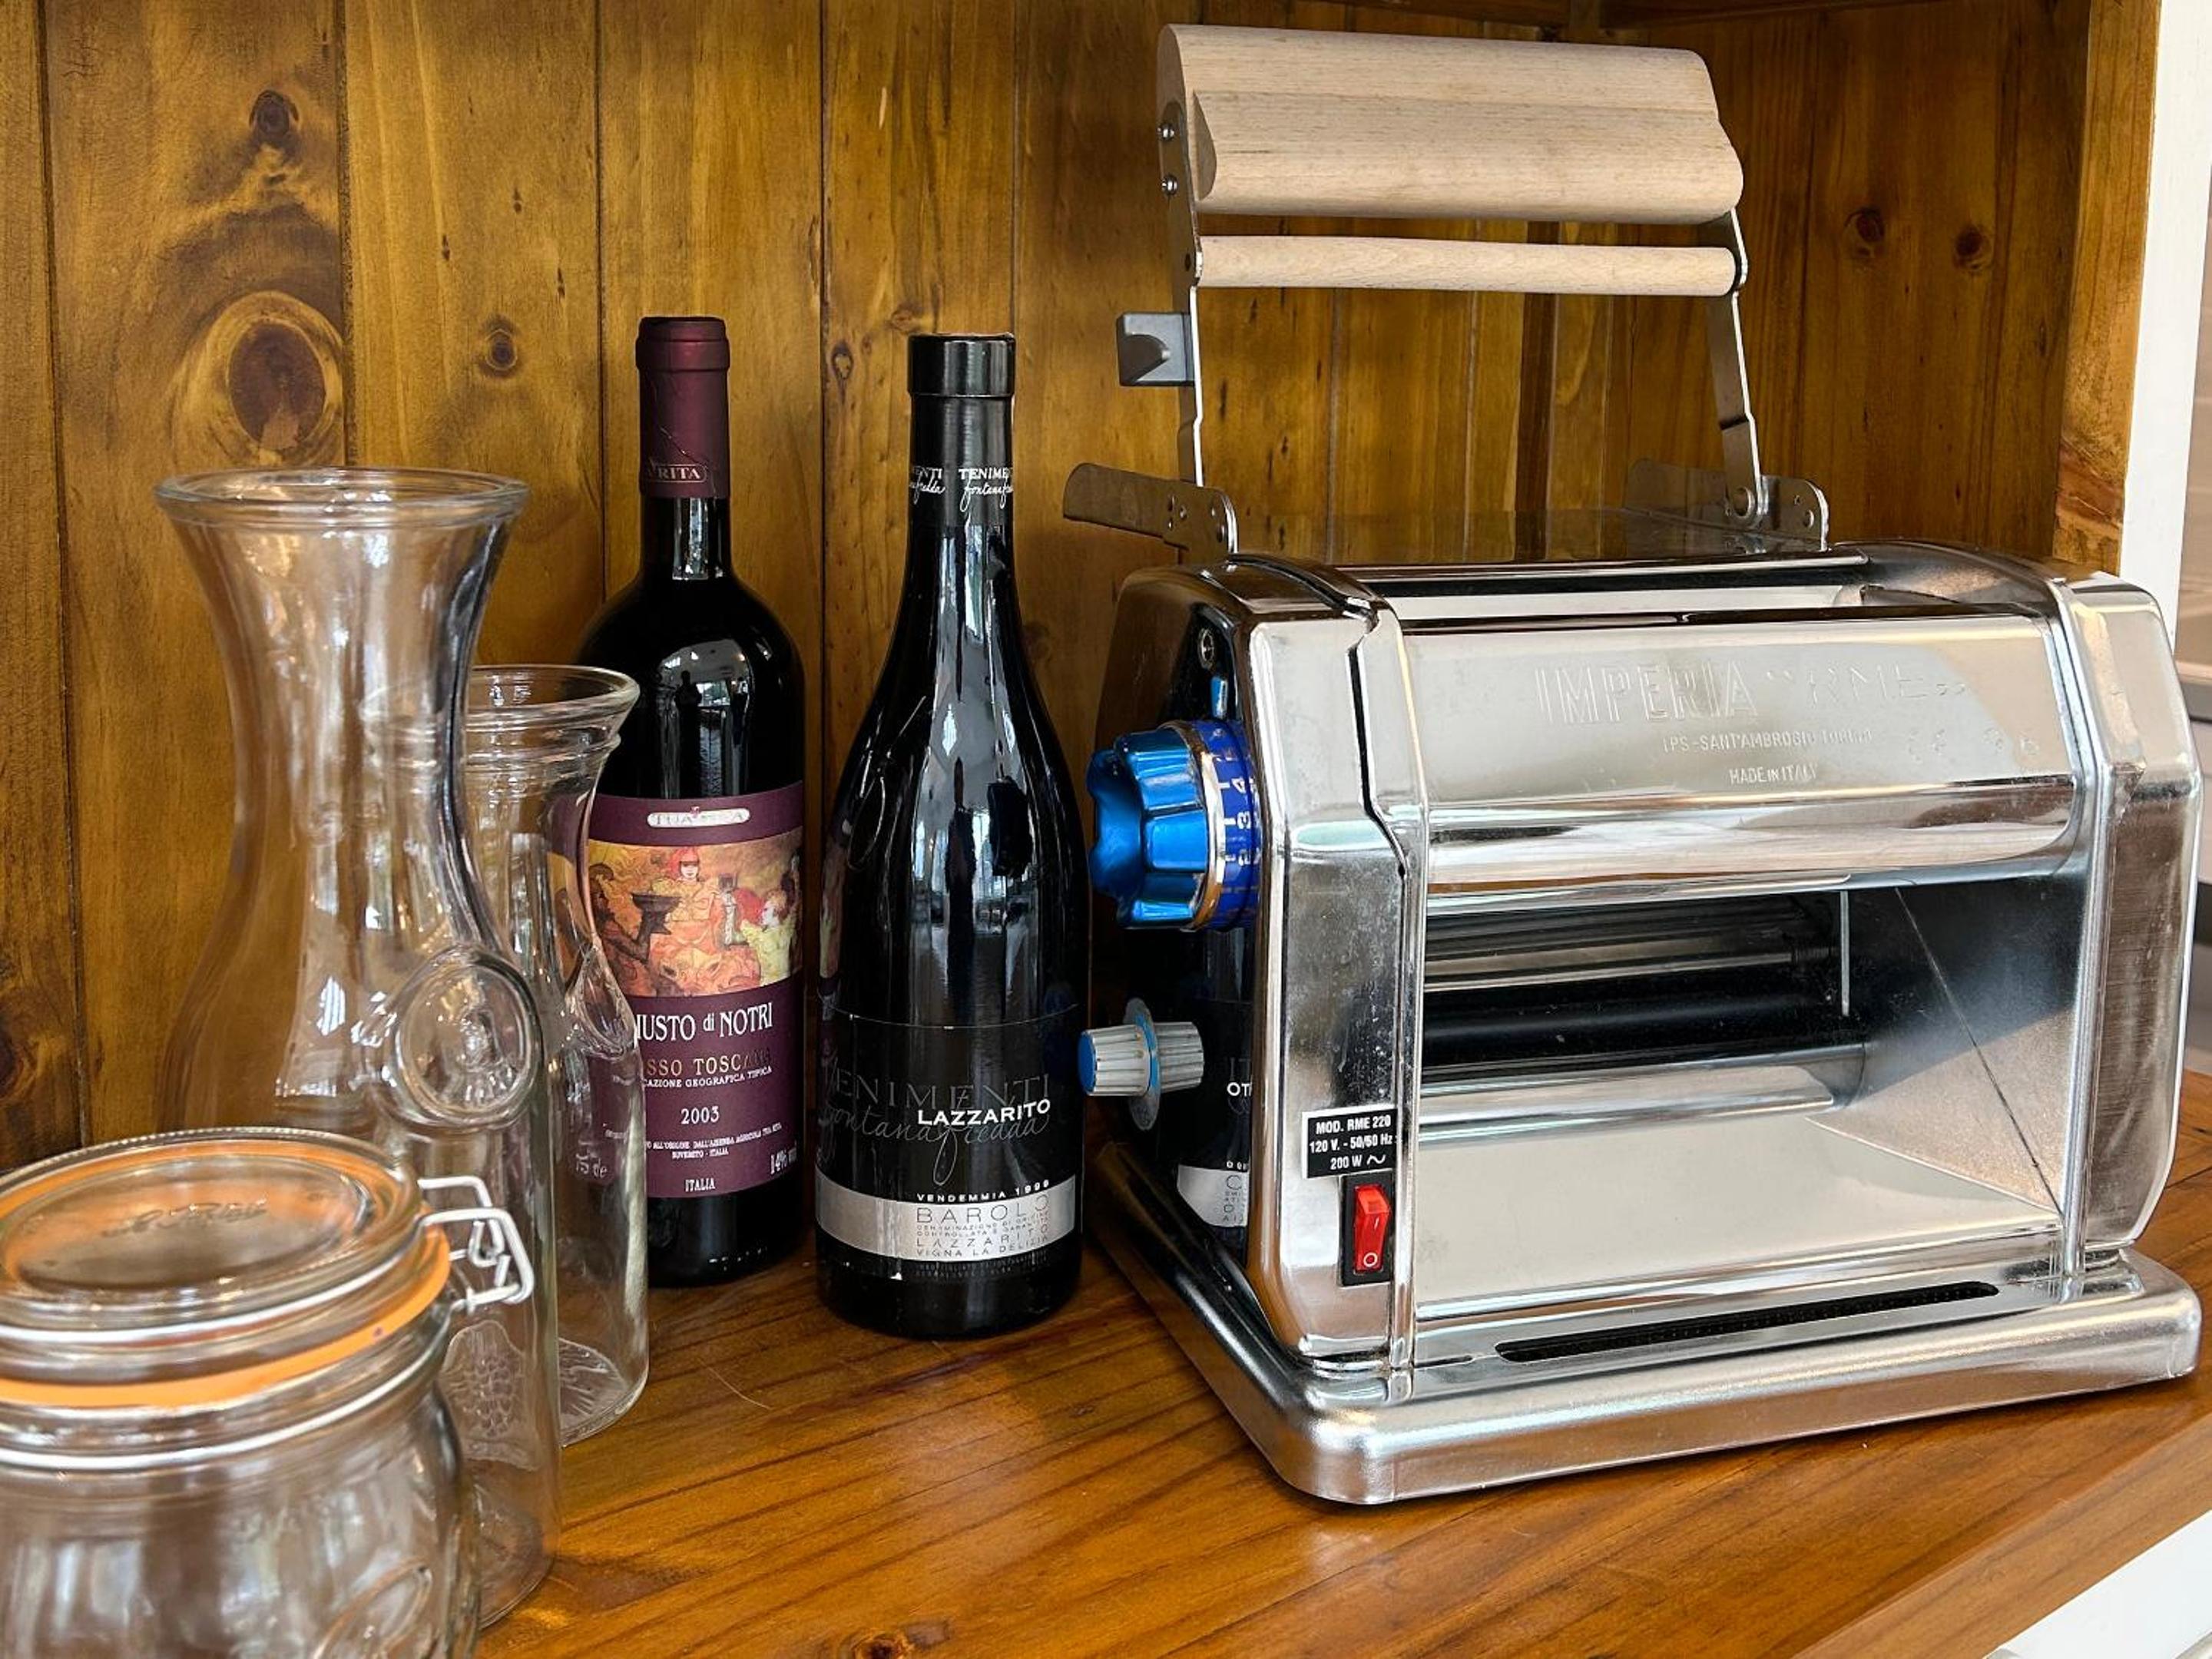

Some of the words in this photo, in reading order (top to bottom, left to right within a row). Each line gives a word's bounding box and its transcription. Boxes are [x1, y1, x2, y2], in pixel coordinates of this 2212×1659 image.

[1535, 661, 1758, 724] IMPERIA
[1728, 768, 1767, 785] MADE
[1780, 763, 1820, 782] ITALY
[703, 1013, 715, 1031] di
[720, 1002, 773, 1038] NOTRI
[685, 1073, 745, 1088] GEOGRAFICA
[680, 1105, 720, 1125] 2003
[918, 1098, 1051, 1126] LAZZARITO
[1316, 1120, 1344, 1134] MOD.
[1347, 1117, 1370, 1131] RME
[1372, 1114, 1392, 1129] 220
[1310, 1139, 1329, 1154] 120
[1330, 1137, 1340, 1151] V.
[1380, 1133, 1393, 1145] Hz
[1330, 1157, 1350, 1171] 200
[1352, 1154, 1363, 1167] W
[685, 1177, 716, 1192] ITALIA
[916, 1191, 1007, 1203] VENDEMMIA
[916, 1194, 1049, 1224] BAROLO
[916, 1224, 1049, 1249] LAZZARITO
[972, 1248, 990, 1257] LA
